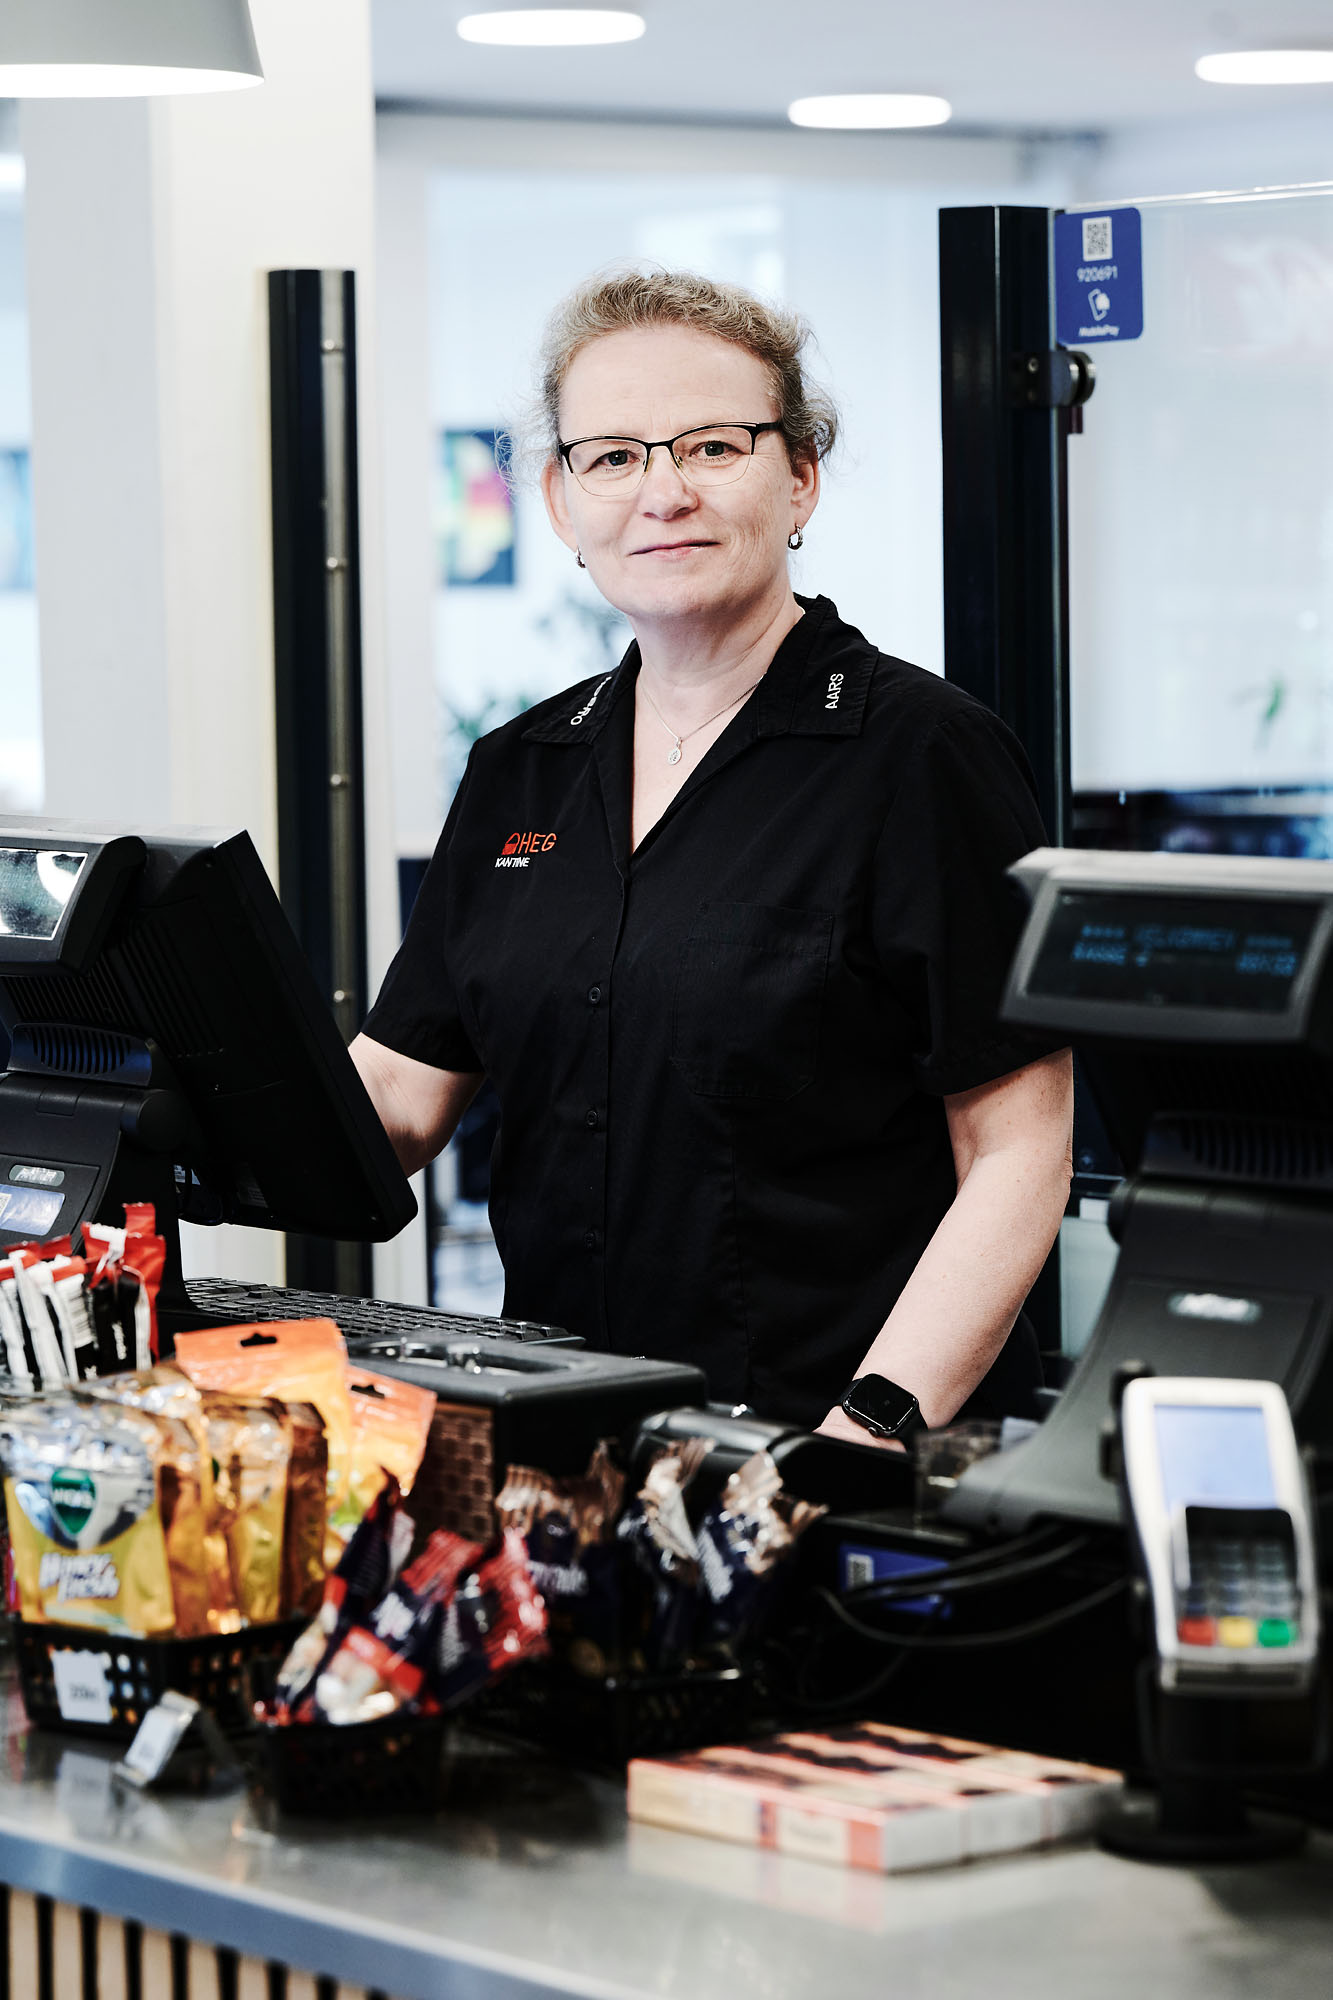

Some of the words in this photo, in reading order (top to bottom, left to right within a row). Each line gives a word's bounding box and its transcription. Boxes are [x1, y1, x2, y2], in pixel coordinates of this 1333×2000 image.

[824, 673, 845, 709] AARS
[517, 832, 557, 854] HEG
[494, 856, 531, 868] KANTINE
